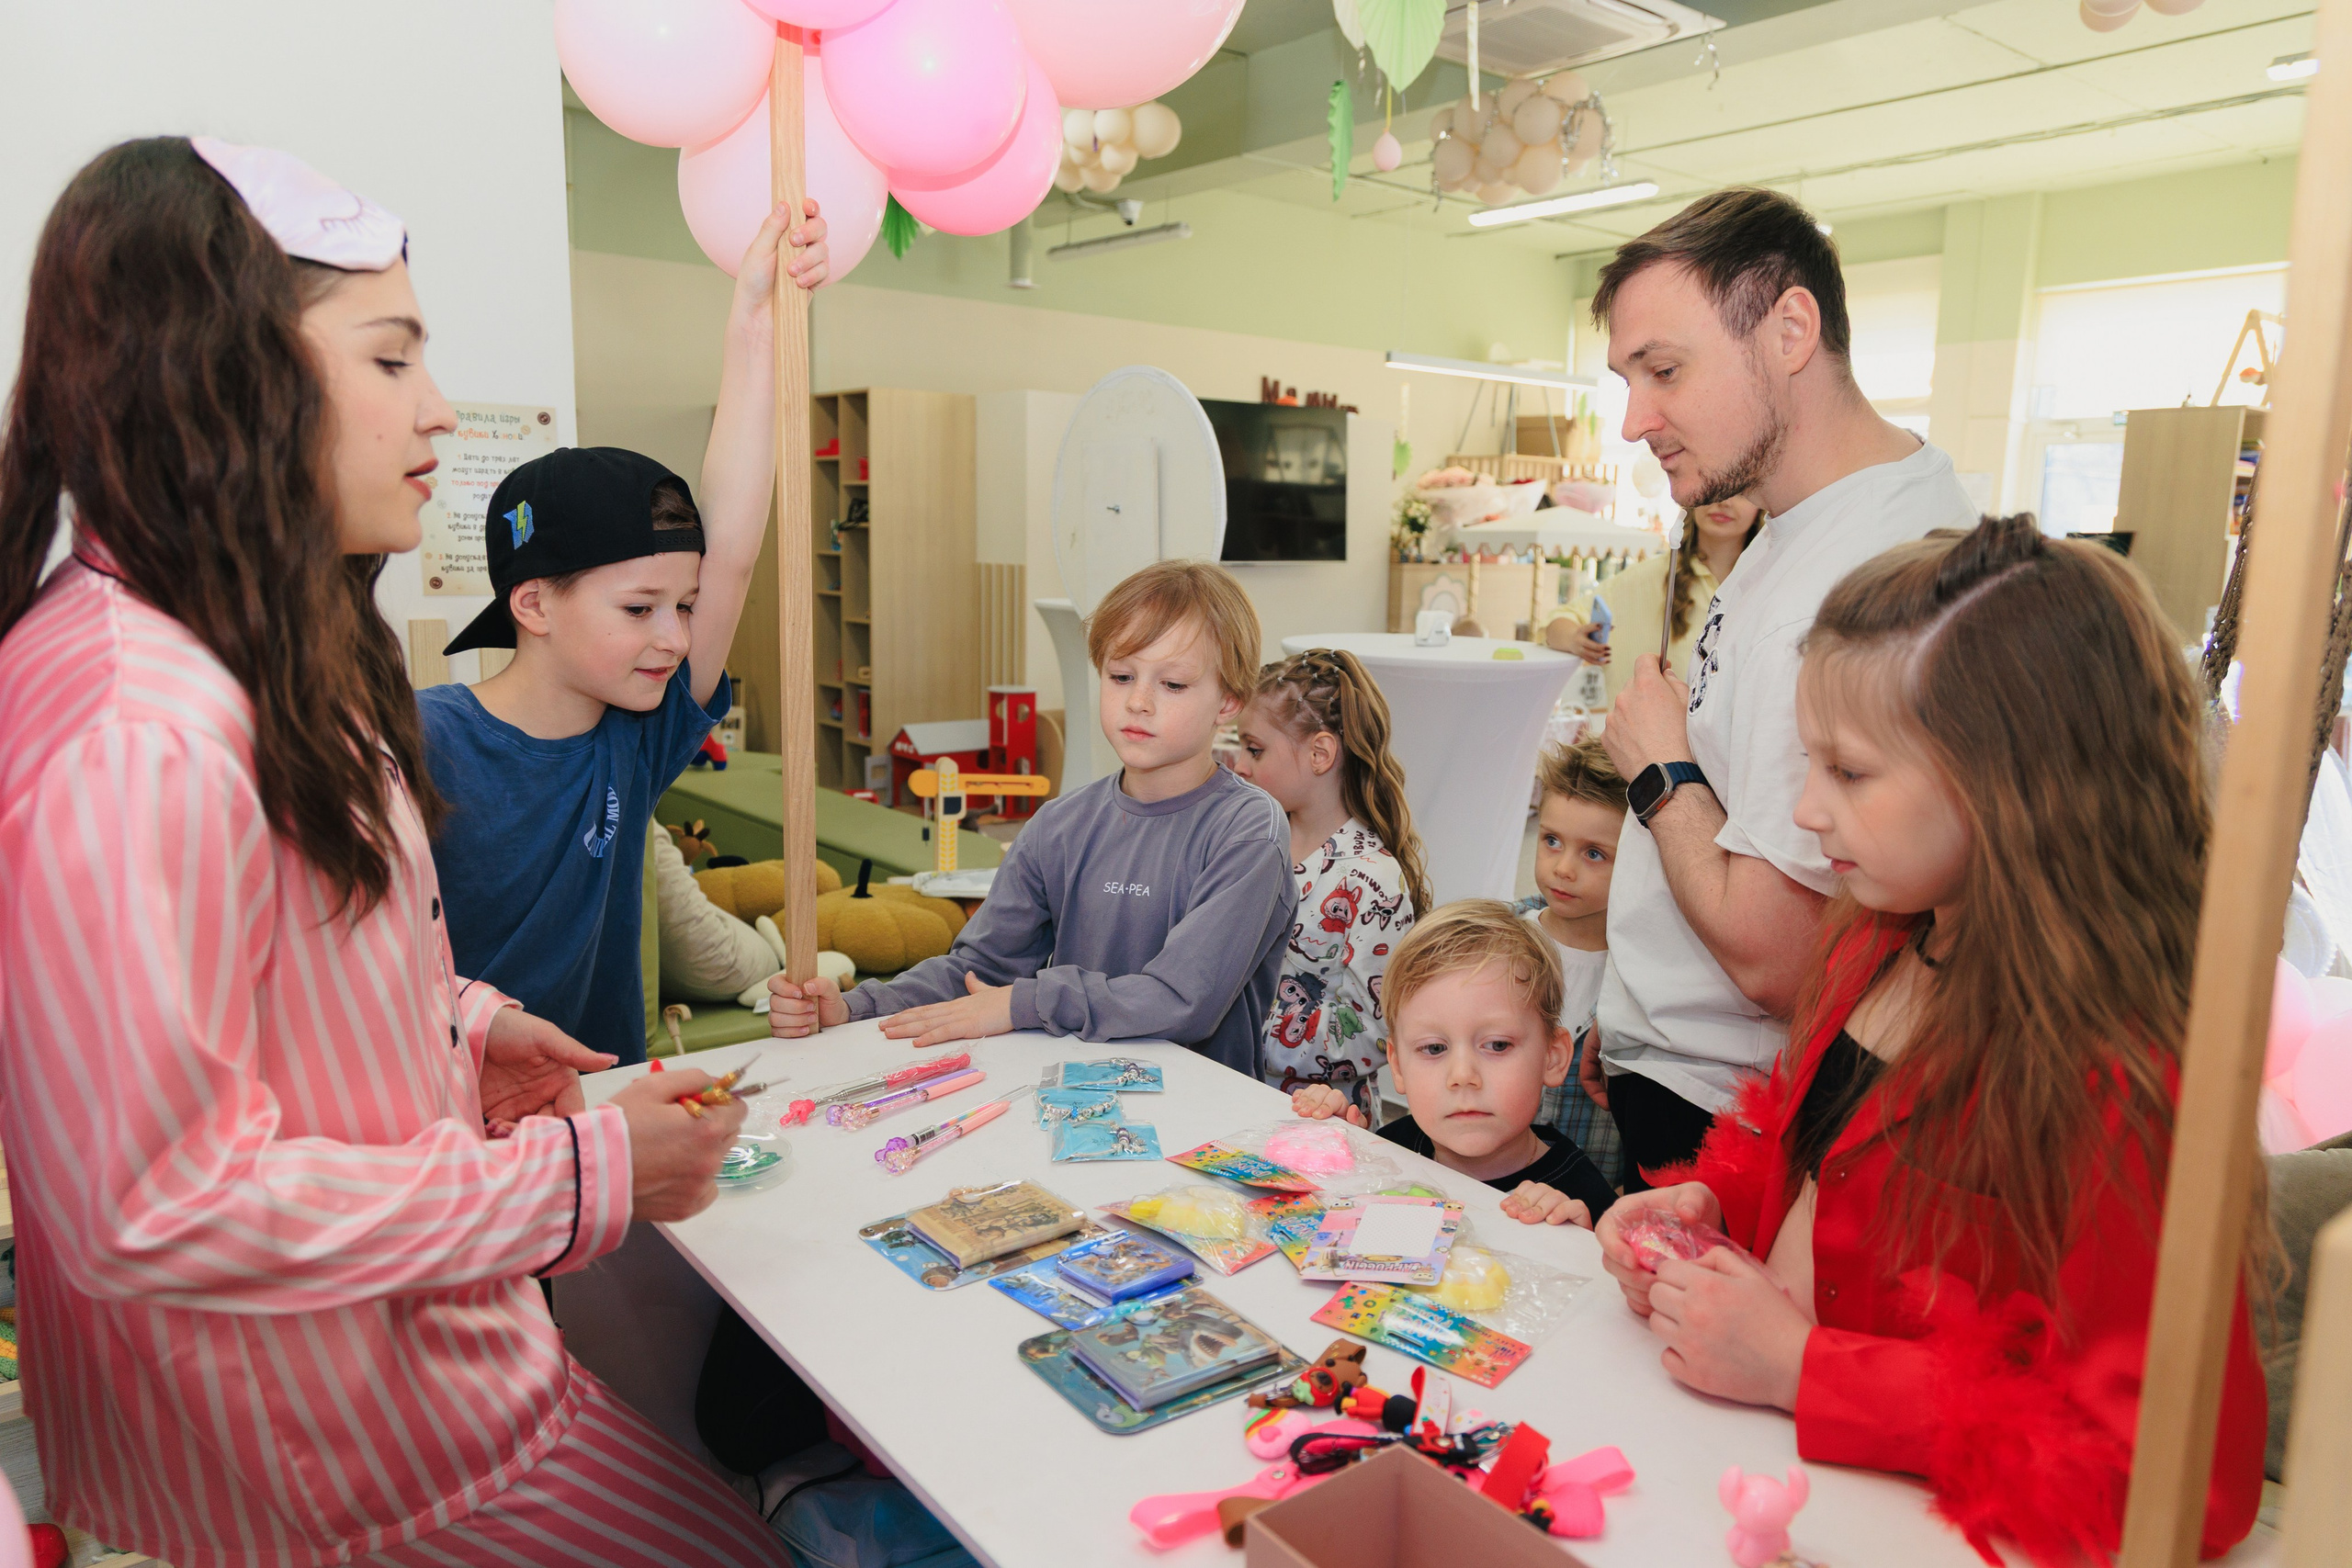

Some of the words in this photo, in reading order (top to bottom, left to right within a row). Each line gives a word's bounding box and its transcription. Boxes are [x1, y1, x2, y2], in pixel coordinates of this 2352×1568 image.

[456, 410, 497, 424] Правила
[499, 412, 521, 425] игры
[457, 427, 490, 441] кубики
[463, 453, 480, 461] Дети
[481, 455, 490, 464] до
[451, 468, 473, 476] могут
[473, 468, 496, 476] играть
[450, 479, 475, 488] только
[476, 480, 489, 490] под
